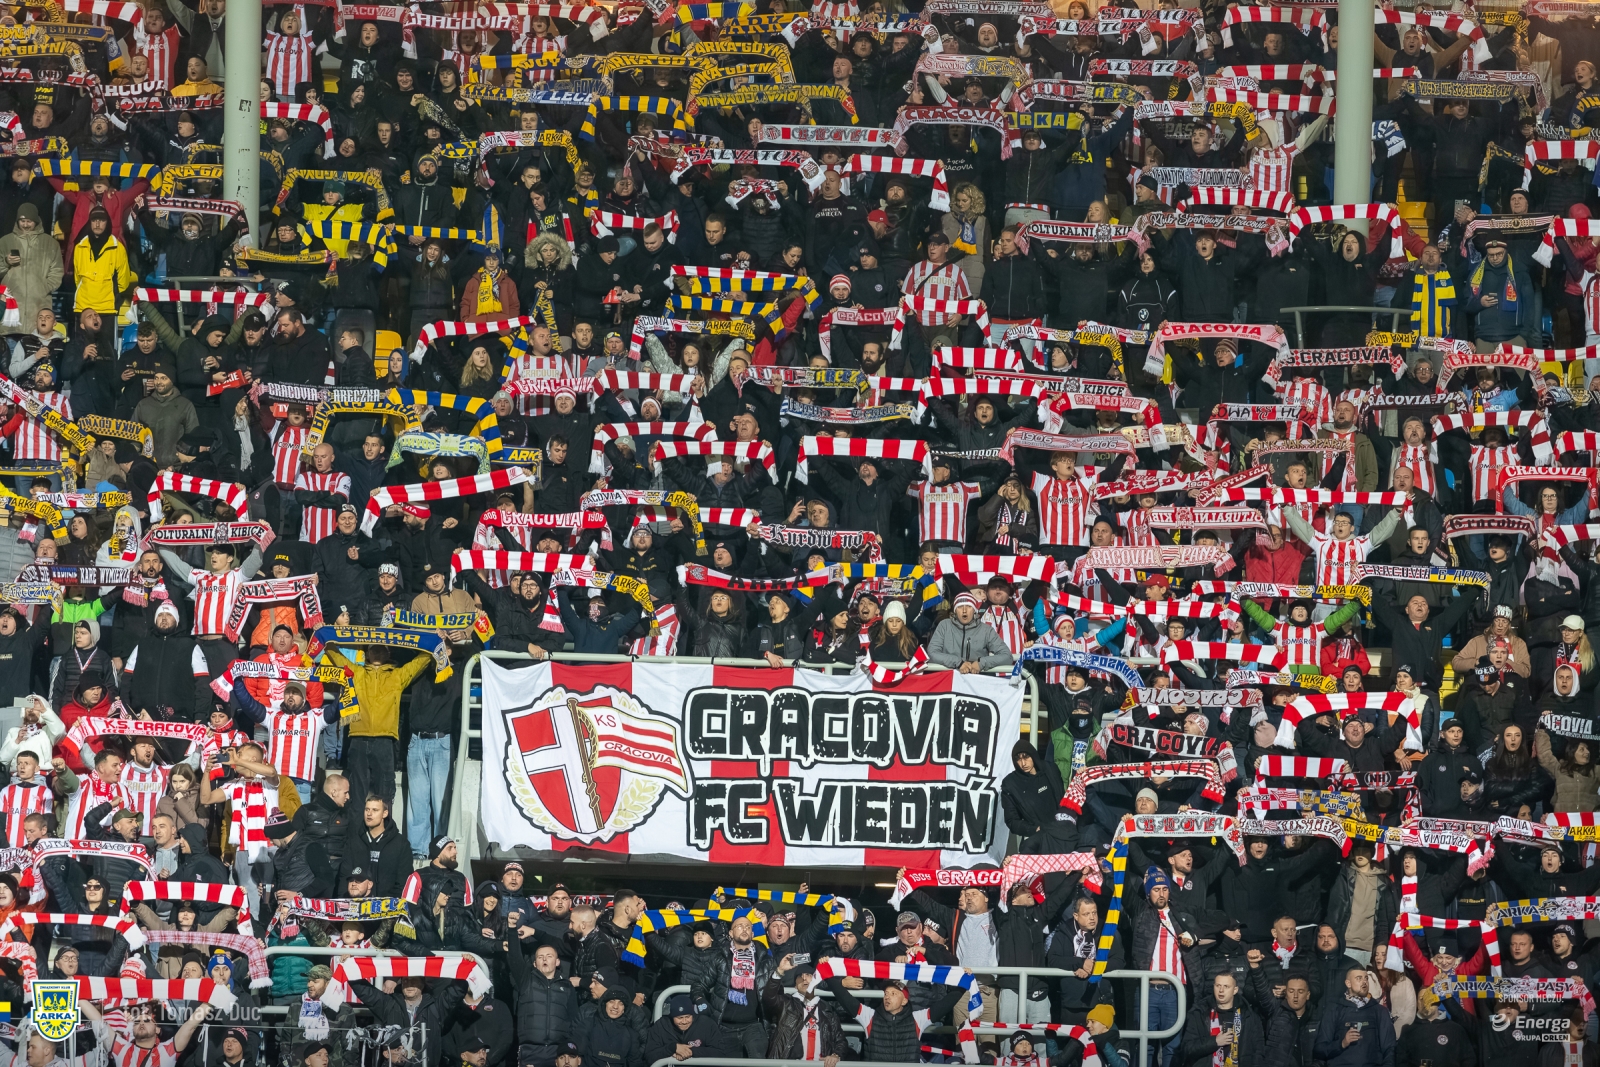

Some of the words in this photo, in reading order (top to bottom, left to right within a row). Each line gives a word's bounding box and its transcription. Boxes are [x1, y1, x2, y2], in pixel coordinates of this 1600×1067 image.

[343, 5, 396, 18] RACOVIA
[1101, 8, 1199, 24] SALVATOR
[729, 14, 792, 35] ARK
[658, 56, 716, 70] GDYN
[1089, 60, 1197, 75] SALVATOR
[1094, 85, 1138, 99] ARECZ
[120, 96, 163, 111] OWA
[1209, 103, 1234, 112] ARKA
[905, 107, 1006, 125] CRACOVIA
[1008, 113, 1065, 127] ARKA
[538, 132, 563, 143] ARKA
[688, 149, 802, 163] SALVATOR
[943, 163, 973, 171] RACOVIA
[1151, 213, 1176, 224] Klub
[1178, 213, 1223, 227] Sportowy
[1226, 216, 1267, 229] Cracovia
[837, 310, 898, 323] CRACOVI
[706, 321, 731, 330] ARKA
[1006, 326, 1033, 336] COVIA
[1161, 324, 1261, 336] CRACOVIA
[1076, 331, 1102, 343] ARKA
[1300, 350, 1389, 364] CRACOVIA
[1451, 354, 1528, 366] CRACOVIA
[816, 369, 859, 382] ARECZ
[268, 383, 318, 400] CRACOVIA
[333, 389, 380, 401] ARECZKA
[1084, 384, 1124, 396] KIBICE
[1075, 395, 1142, 409] CRACOVIA
[1369, 394, 1431, 405] RACOVIA
[1218, 404, 1249, 418] OWA
[43, 410, 67, 431] ARKA
[1021, 432, 1052, 443] 1906
[1082, 440, 1117, 449] 2006
[278, 441, 304, 449] COMAR
[1506, 466, 1587, 476] CRACOVIA
[11, 496, 37, 511] ARKA
[37, 493, 62, 503] COVIA
[101, 492, 126, 502] ARKA
[589, 492, 622, 503] ACOVIA
[667, 493, 692, 507] ARKA
[501, 511, 582, 527] CRACOVIA
[230, 525, 264, 537] KIBICE
[1364, 565, 1430, 579] CRACOVIA
[613, 576, 638, 590] ARKA
[398, 613, 437, 625] ARKA
[442, 613, 475, 626] 1929
[316, 666, 341, 678] ARKA
[1296, 674, 1323, 685] ARKA
[595, 714, 616, 728] KS
[1540, 713, 1593, 735] ACOVIA
[135, 720, 206, 737] CRACOVIA
[272, 729, 310, 737] COMARCH
[688, 690, 997, 772] CRACOVIA
[1113, 724, 1221, 757] CRACOVIA
[604, 741, 673, 764] CRACOVIA
[695, 781, 764, 847] FC
[774, 777, 995, 850] WIEDEŃ
[1324, 803, 1348, 811] ARKA
[1136, 815, 1224, 832] CRACOVIA
[1569, 826, 1596, 836] ARKA
[937, 870, 1001, 886] CRACO
[1498, 906, 1538, 919] ARKA
[1453, 980, 1494, 992] ARKA
[1536, 981, 1573, 992] PASY
